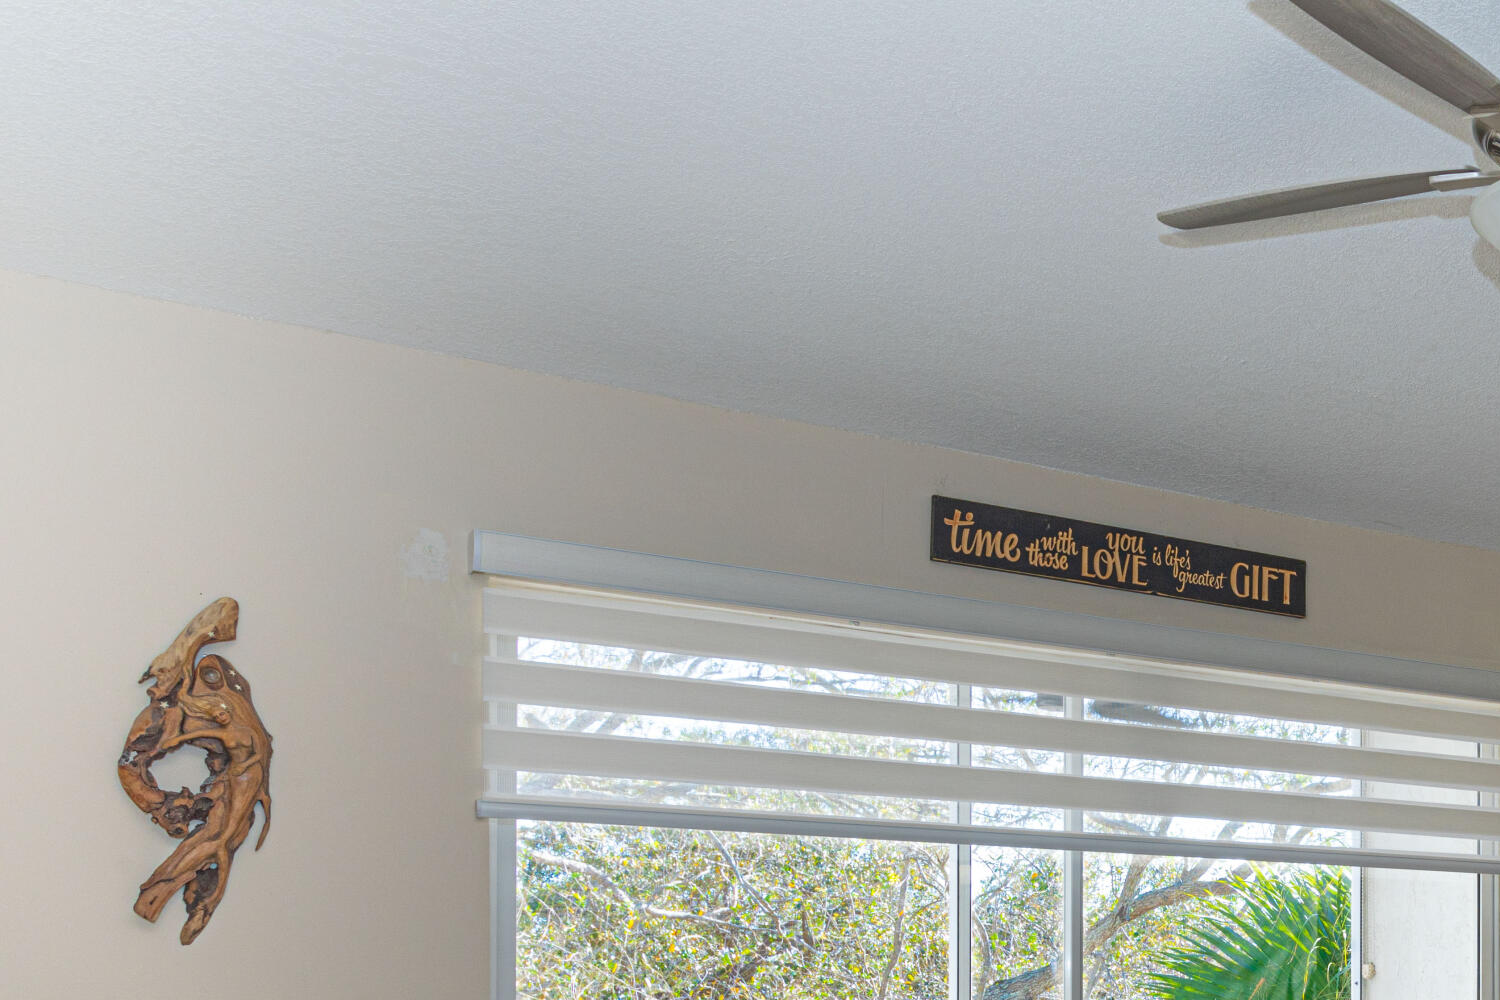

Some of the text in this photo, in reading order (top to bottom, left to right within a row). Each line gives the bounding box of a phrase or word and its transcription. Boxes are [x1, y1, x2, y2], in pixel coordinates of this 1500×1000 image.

[944, 509, 1021, 563] time
[1040, 527, 1079, 556] with
[1105, 531, 1146, 555] you
[1025, 538, 1069, 571] those
[1081, 545, 1148, 587] LOVE
[1152, 543, 1191, 578] is life's
[1176, 569, 1228, 593] greatest
[1230, 561, 1297, 606] GIFT
